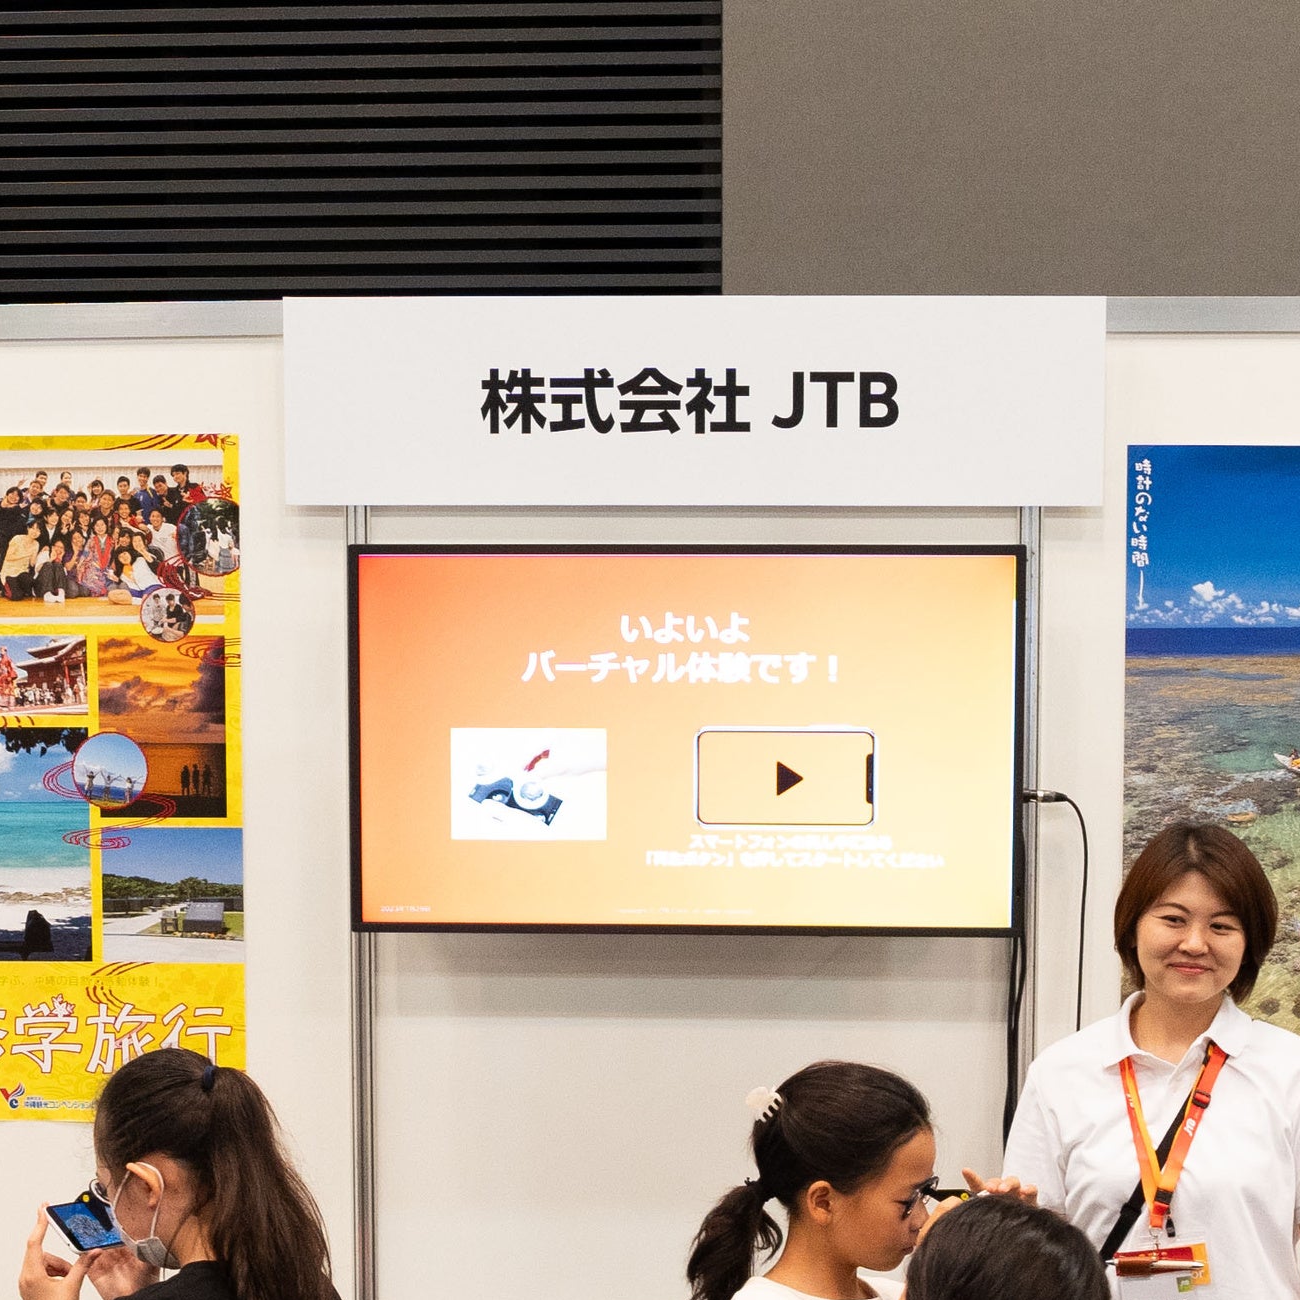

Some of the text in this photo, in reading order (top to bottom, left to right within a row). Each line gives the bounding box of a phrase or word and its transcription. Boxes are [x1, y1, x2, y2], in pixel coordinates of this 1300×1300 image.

[480, 367, 900, 434] 株式会社 JTB
[1131, 458, 1152, 568] 時計のない時間
[620, 611, 750, 643] いよいよ
[521, 650, 839, 684] バーチャル体験です！
